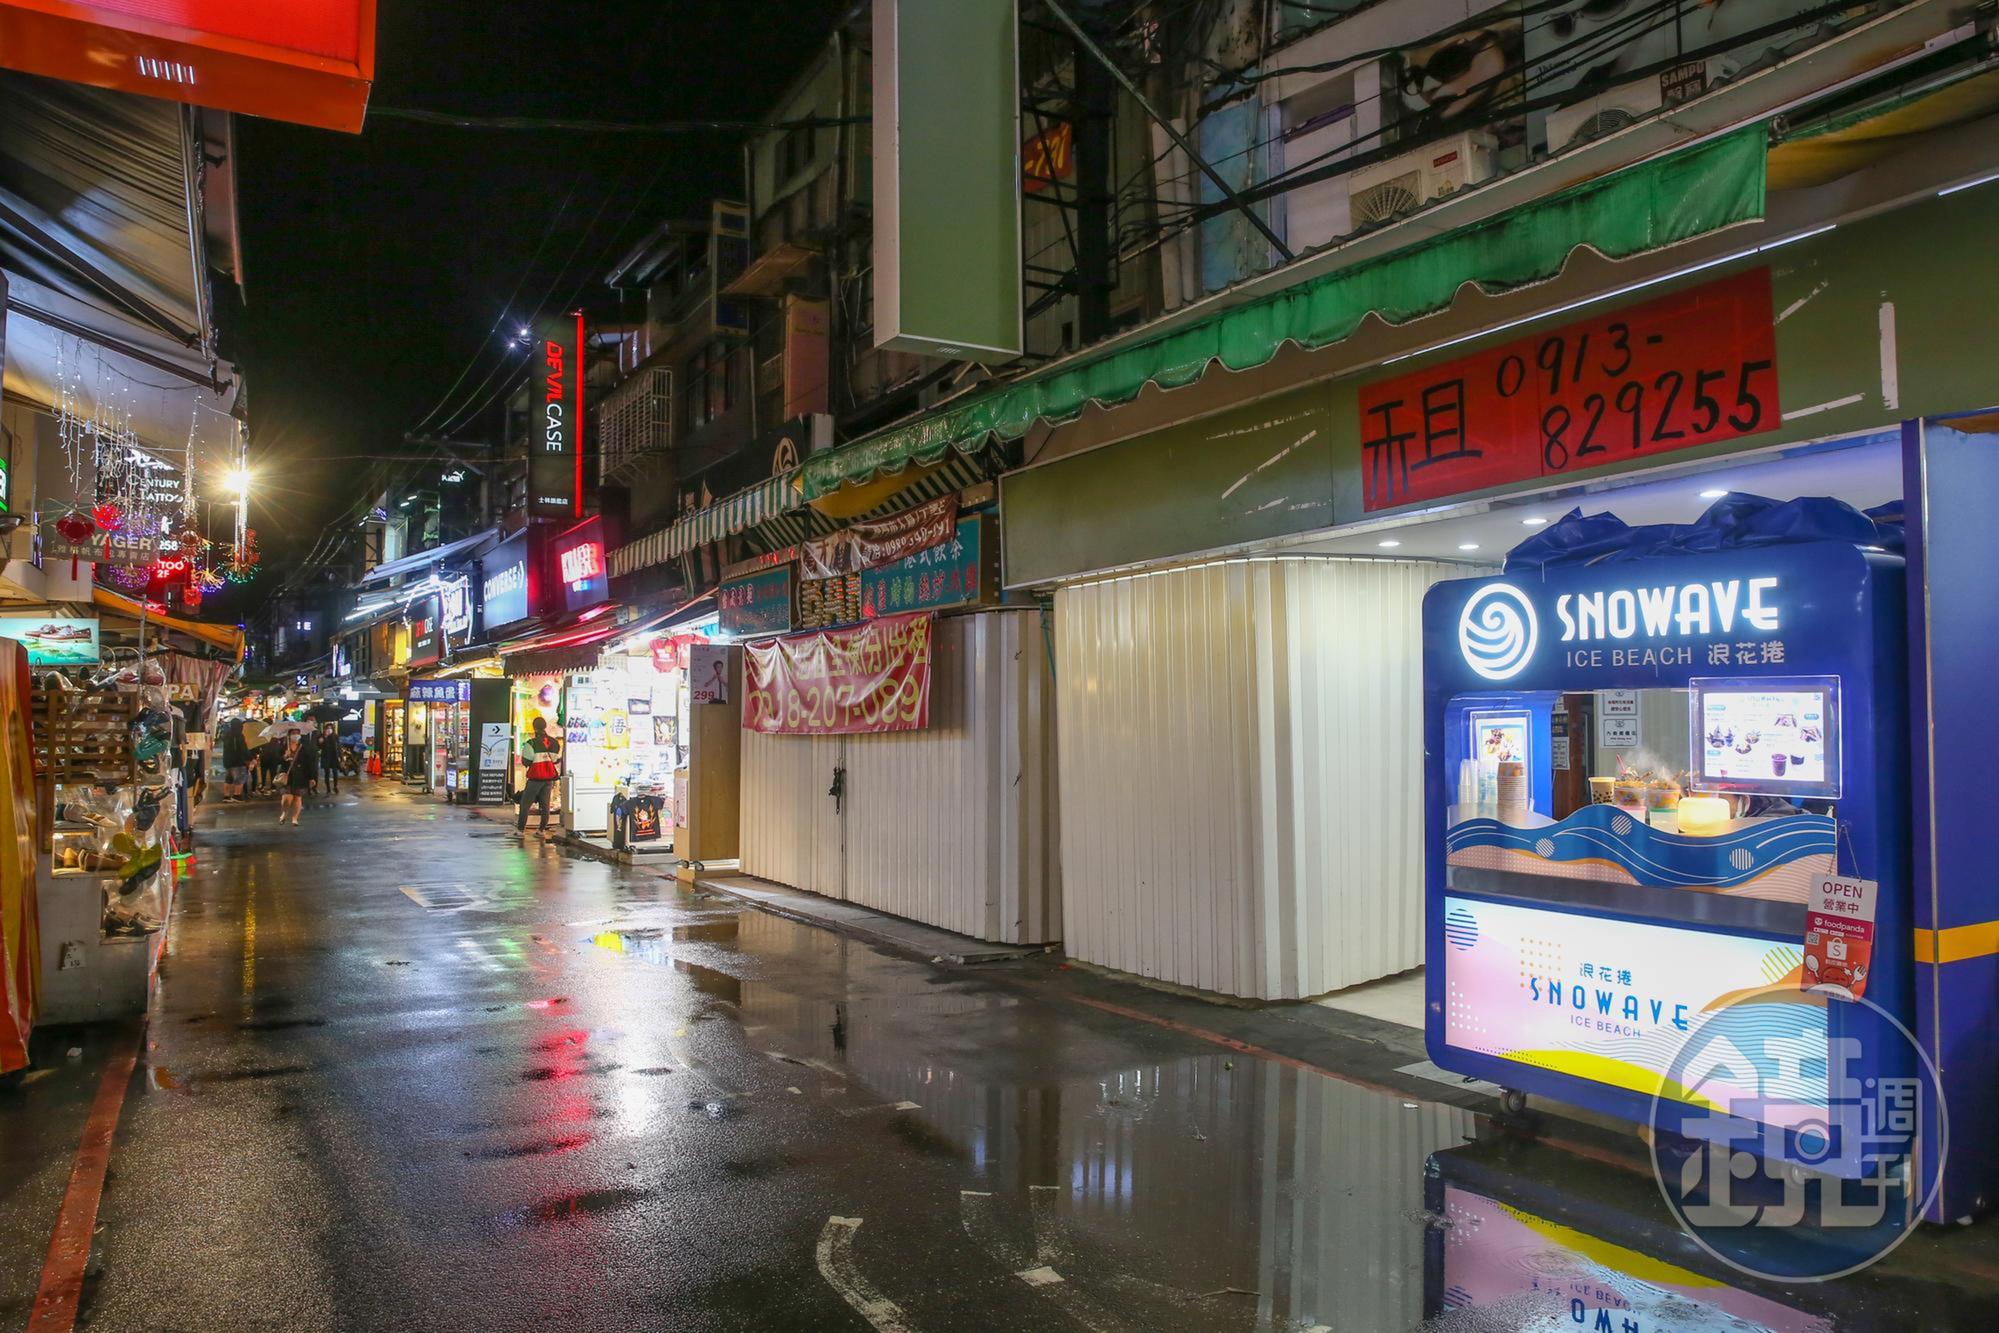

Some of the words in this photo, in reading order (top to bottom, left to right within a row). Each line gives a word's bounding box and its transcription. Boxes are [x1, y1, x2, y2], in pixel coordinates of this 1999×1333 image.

[1541, 359, 1772, 471] 829255
[1363, 378, 1483, 502] 租
[91, 532, 152, 551] YAGER
[156, 570, 170, 578] 2F
[1556, 577, 1779, 642] SNOWAVE
[1567, 650, 1603, 668] ICE
[1612, 648, 1693, 667] BEACH
[1707, 641, 1785, 666] 浪花捲
[694, 691, 715, 701] 299
[1822, 882, 1863, 899] OPEN
[1823, 898, 1859, 914] 營業中
[1824, 919, 1865, 934] foodpanda
[1579, 961, 1632, 987] 浪花捲
[1528, 977, 1690, 1032] SNOWAVE
[1570, 1014, 1592, 1030] ICE
[1596, 1020, 1641, 1039] BEACH
